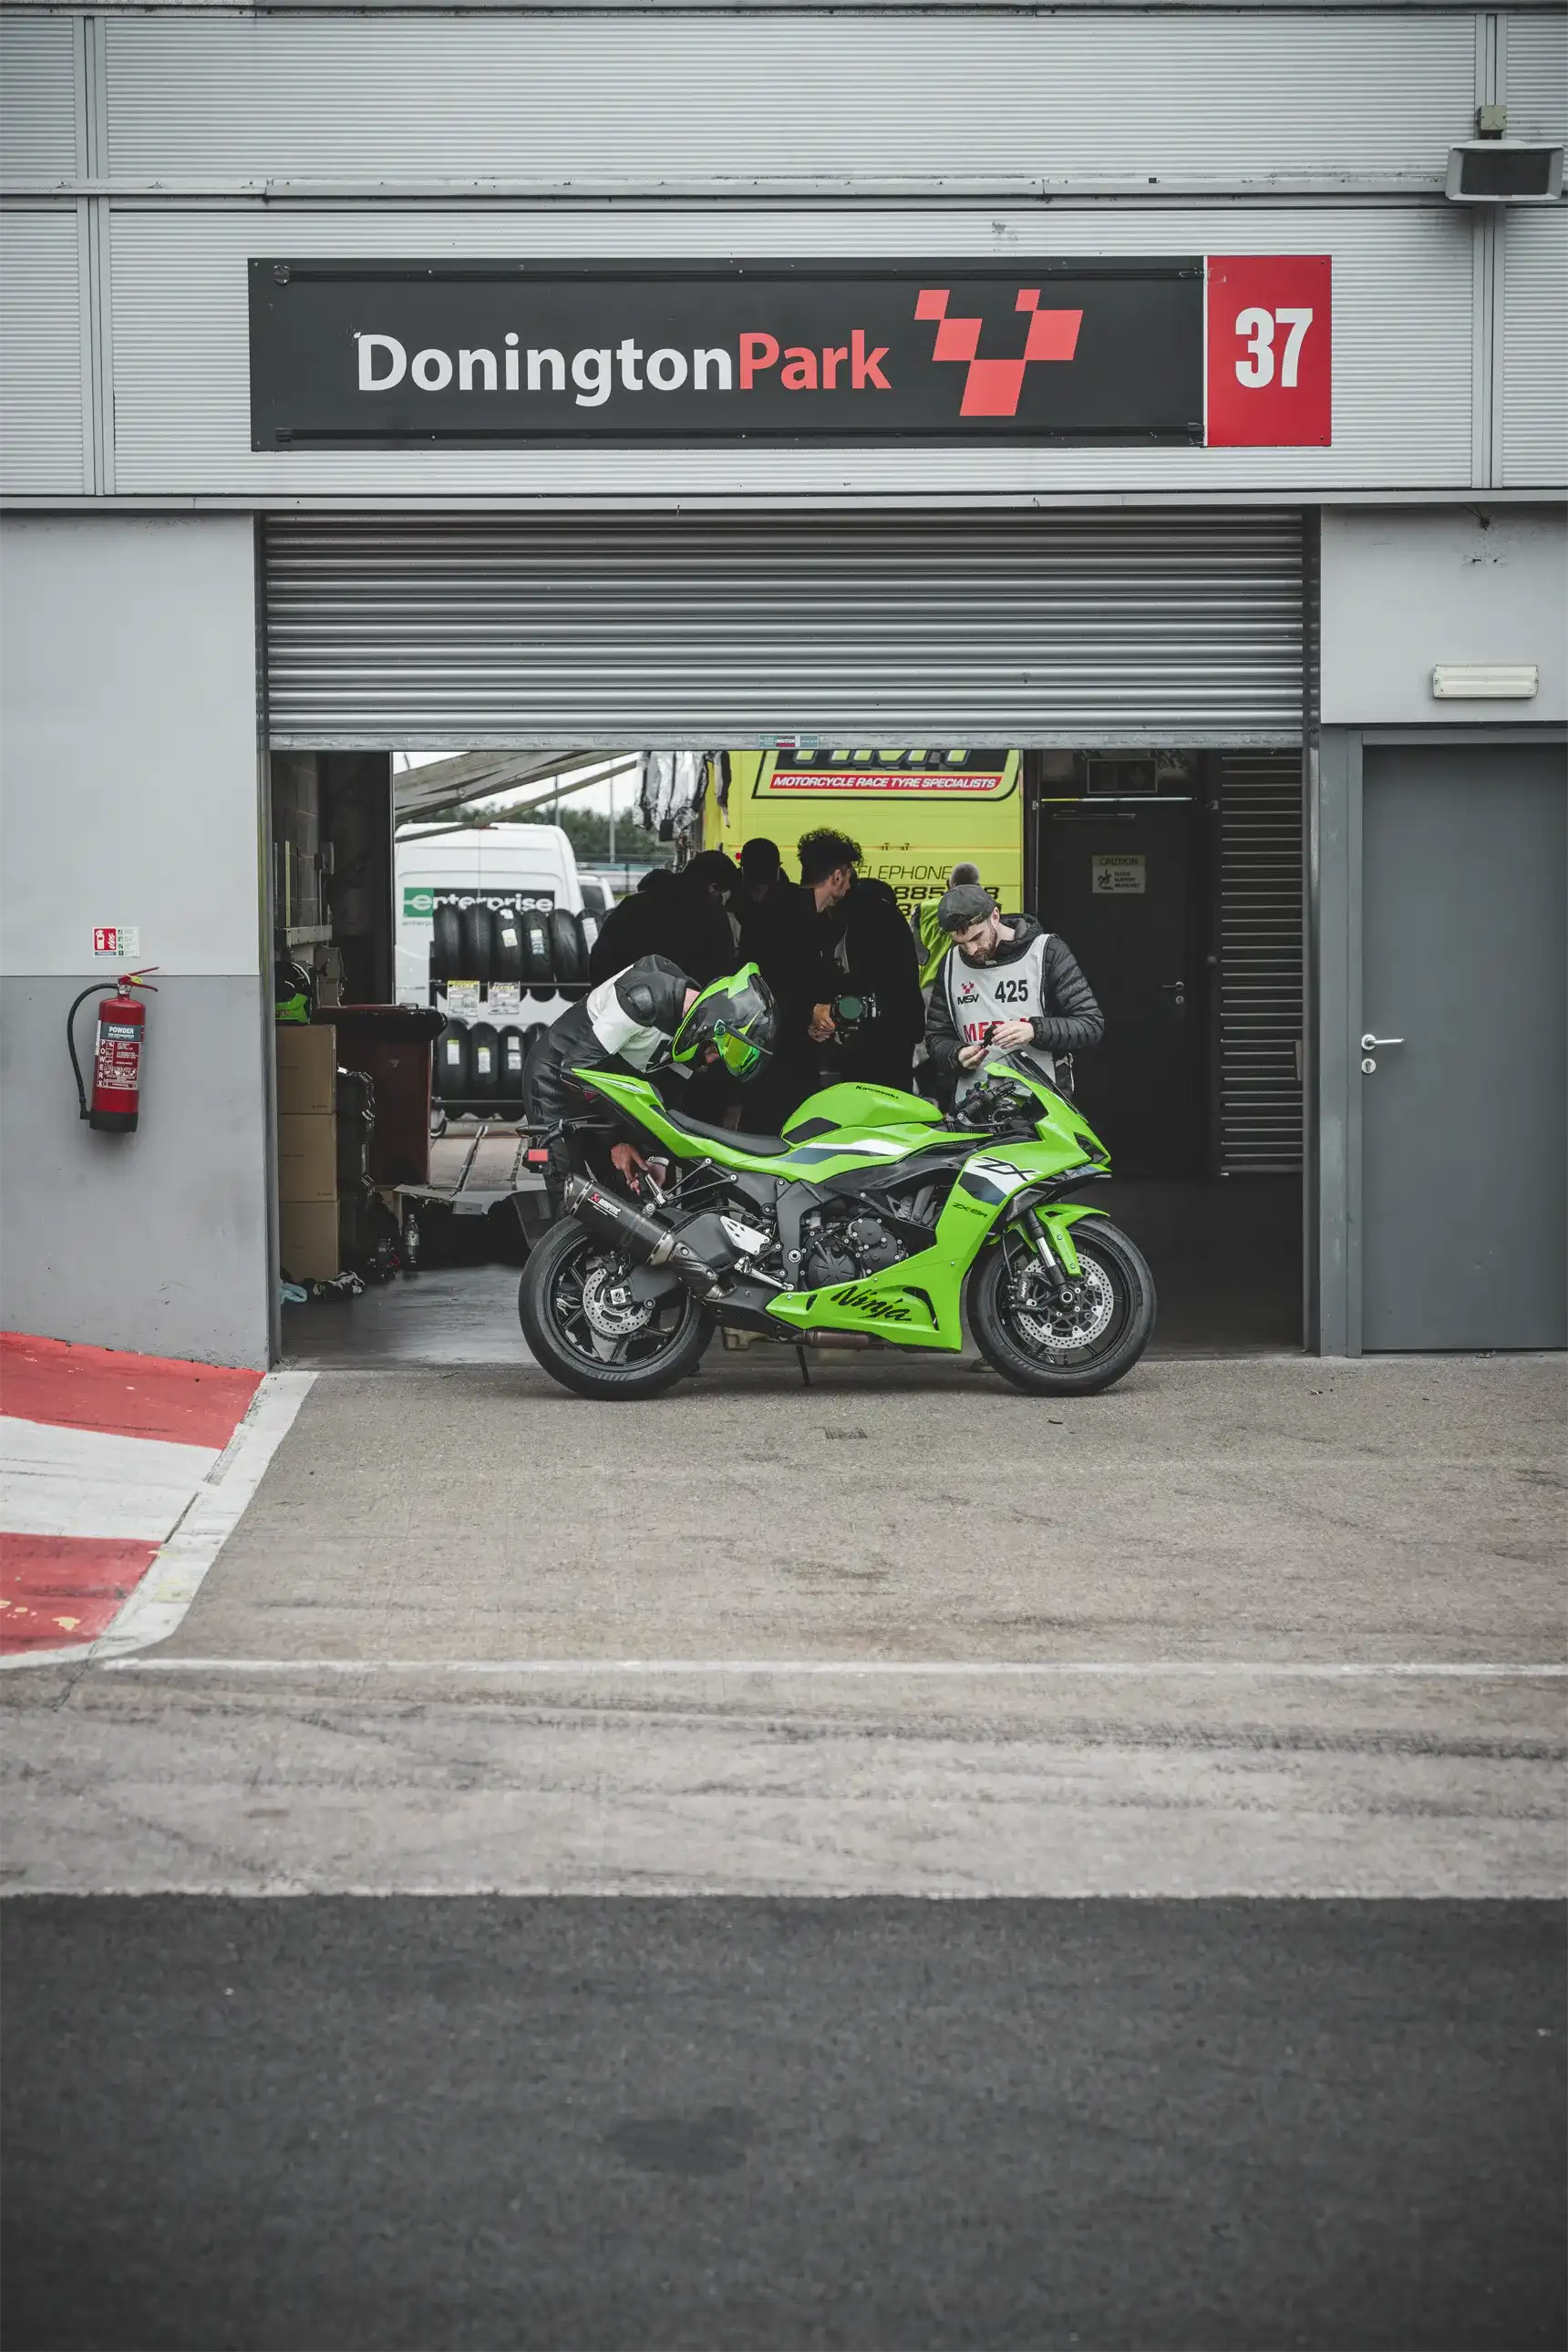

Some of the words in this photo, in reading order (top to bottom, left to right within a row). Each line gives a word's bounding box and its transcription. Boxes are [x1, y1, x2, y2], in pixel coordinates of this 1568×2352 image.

[1235, 307, 1314, 388] 37
[357, 329, 892, 407] DoningtonPark
[774, 777, 854, 787] MOTORCYCLE
[856, 778, 887, 787] RACE
[891, 778, 922, 788] TYRE
[923, 778, 996, 789] SPECIALISTS
[1099, 857, 1139, 866] CAUTION
[858, 865, 953, 881] ELEPHONE
[995, 979, 1029, 1004] 425
[957, 993, 980, 1006] MSV
[109, 1026, 134, 1035] POWDER
[855, 1085, 899, 1099] Kawasaki
[830, 1285, 913, 1322] Ninja
